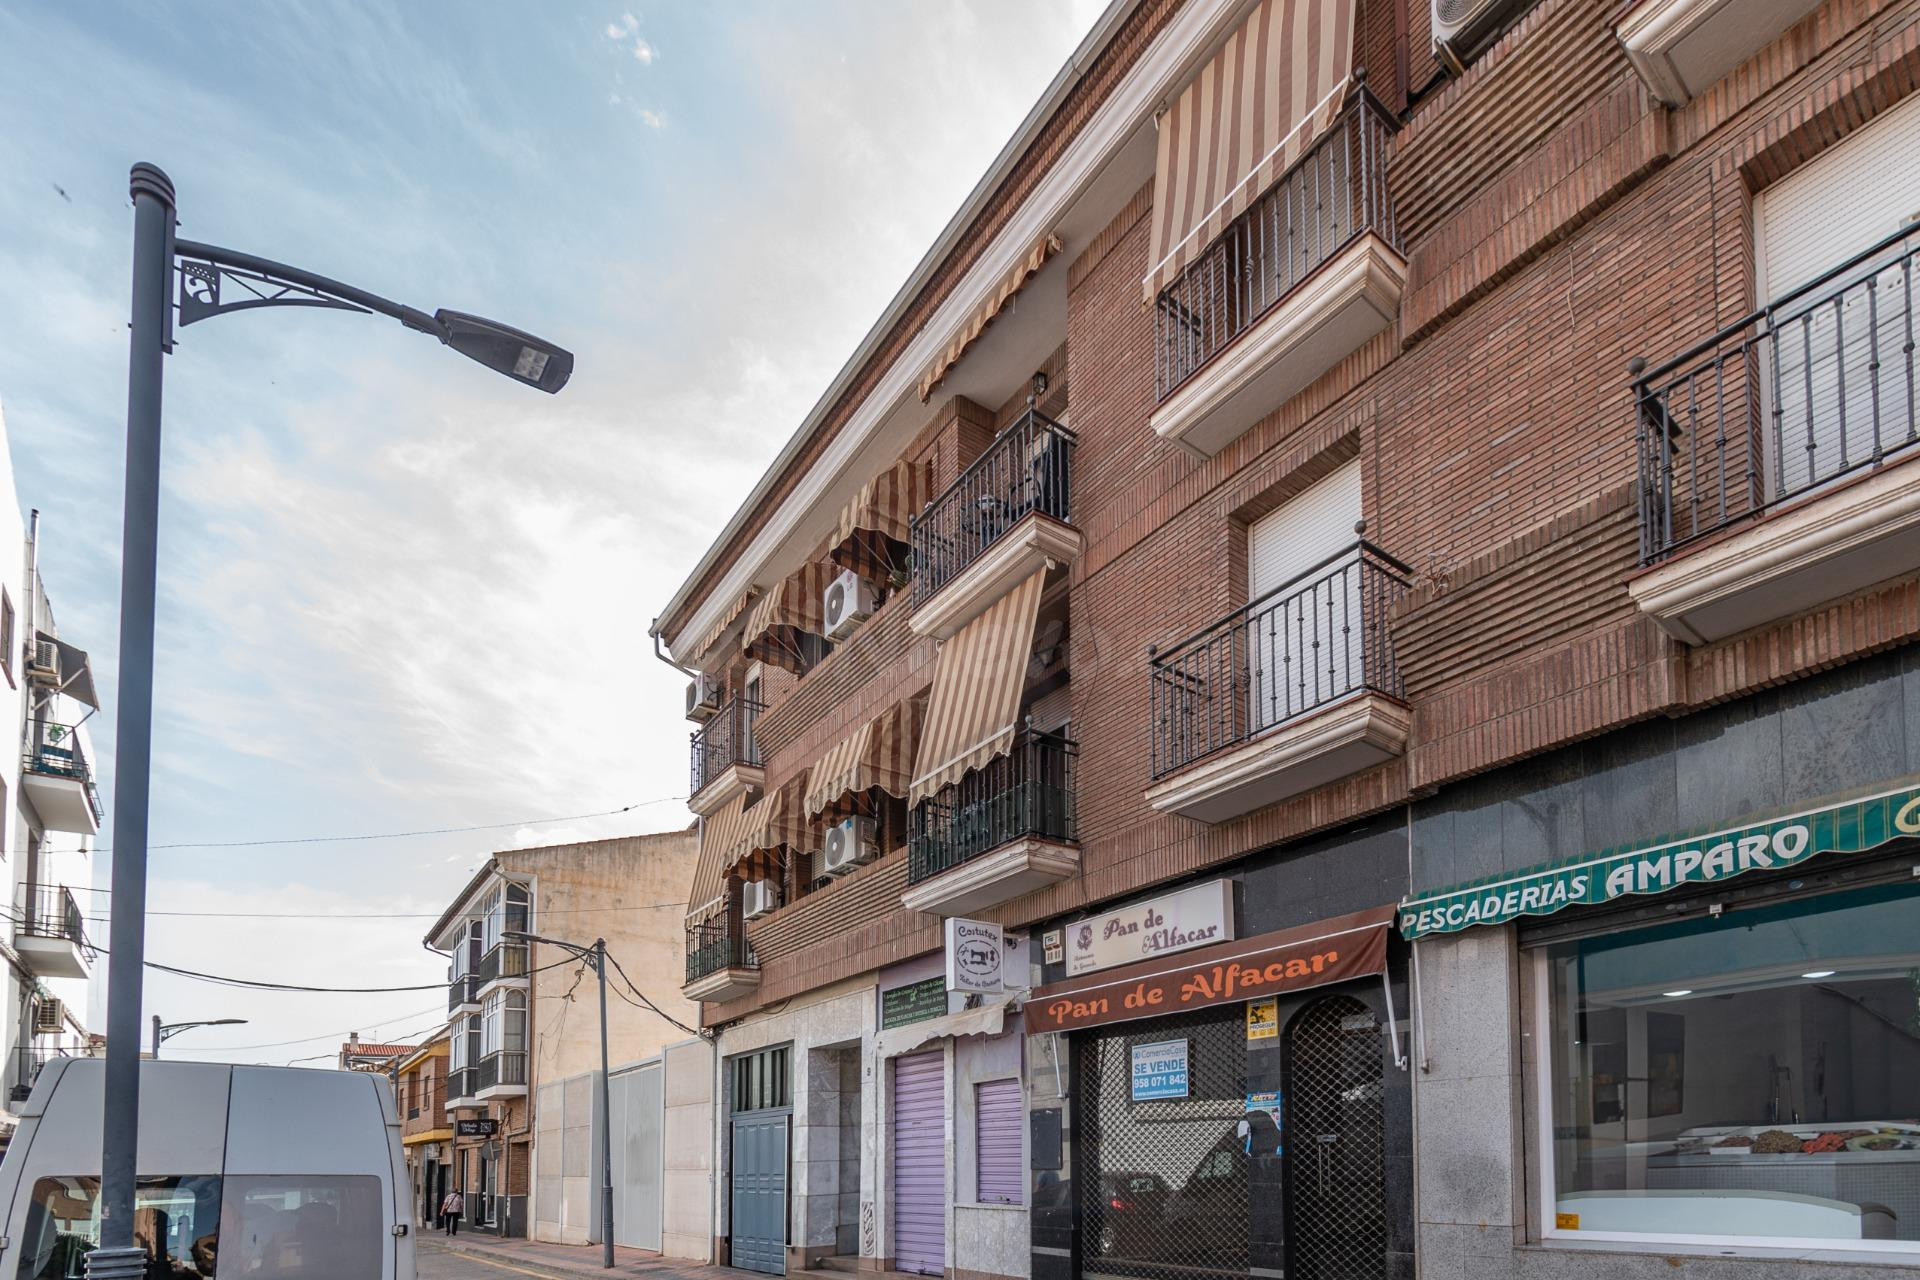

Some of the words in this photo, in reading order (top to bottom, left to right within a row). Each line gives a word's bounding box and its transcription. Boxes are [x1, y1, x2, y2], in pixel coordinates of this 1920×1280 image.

[1401, 875, 1590, 933] PESCADERIAS
[1605, 824, 1810, 897] AMPARO
[958, 926, 998, 942] Costutex
[1103, 917, 1139, 940] Pan
[1144, 908, 1164, 928] de
[1141, 925, 1217, 954] Alfacar
[1048, 998, 1109, 1024] Pan
[1124, 983, 1163, 1009] de
[1181, 950, 1339, 1002] Alfacar
[1134, 1063, 1147, 1074] SE
[1150, 1058, 1185, 1073] VENDE
[1134, 1077, 1149, 1089] 958
[1151, 1076, 1166, 1087] 071
[1169, 1074, 1186, 1085] 842
